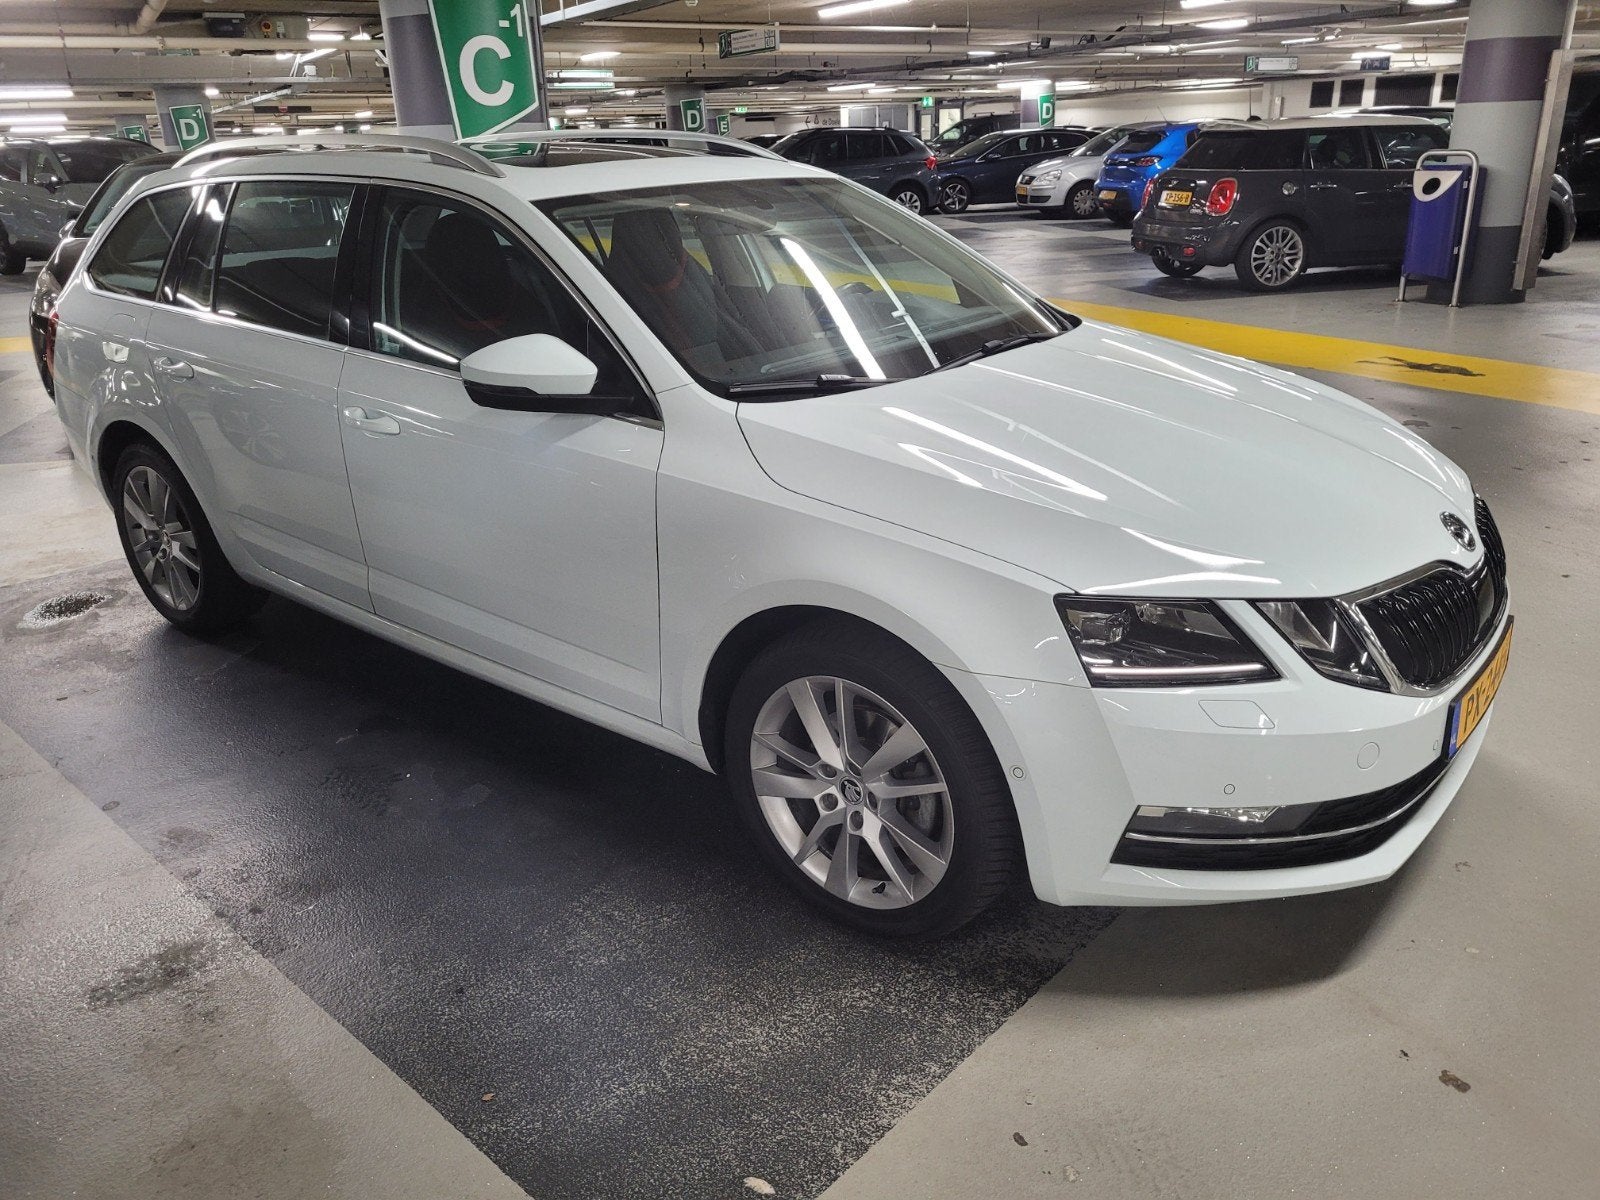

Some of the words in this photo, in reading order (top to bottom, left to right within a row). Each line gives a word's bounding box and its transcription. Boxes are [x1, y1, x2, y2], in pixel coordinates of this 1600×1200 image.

[498, 3, 523, 37] -1
[459, 34, 515, 107] C
[192, 108, 202, 119] -1
[686, 109, 701, 129] D
[1042, 102, 1053, 119] D
[179, 118, 200, 140] D
[720, 121, 728, 132] E
